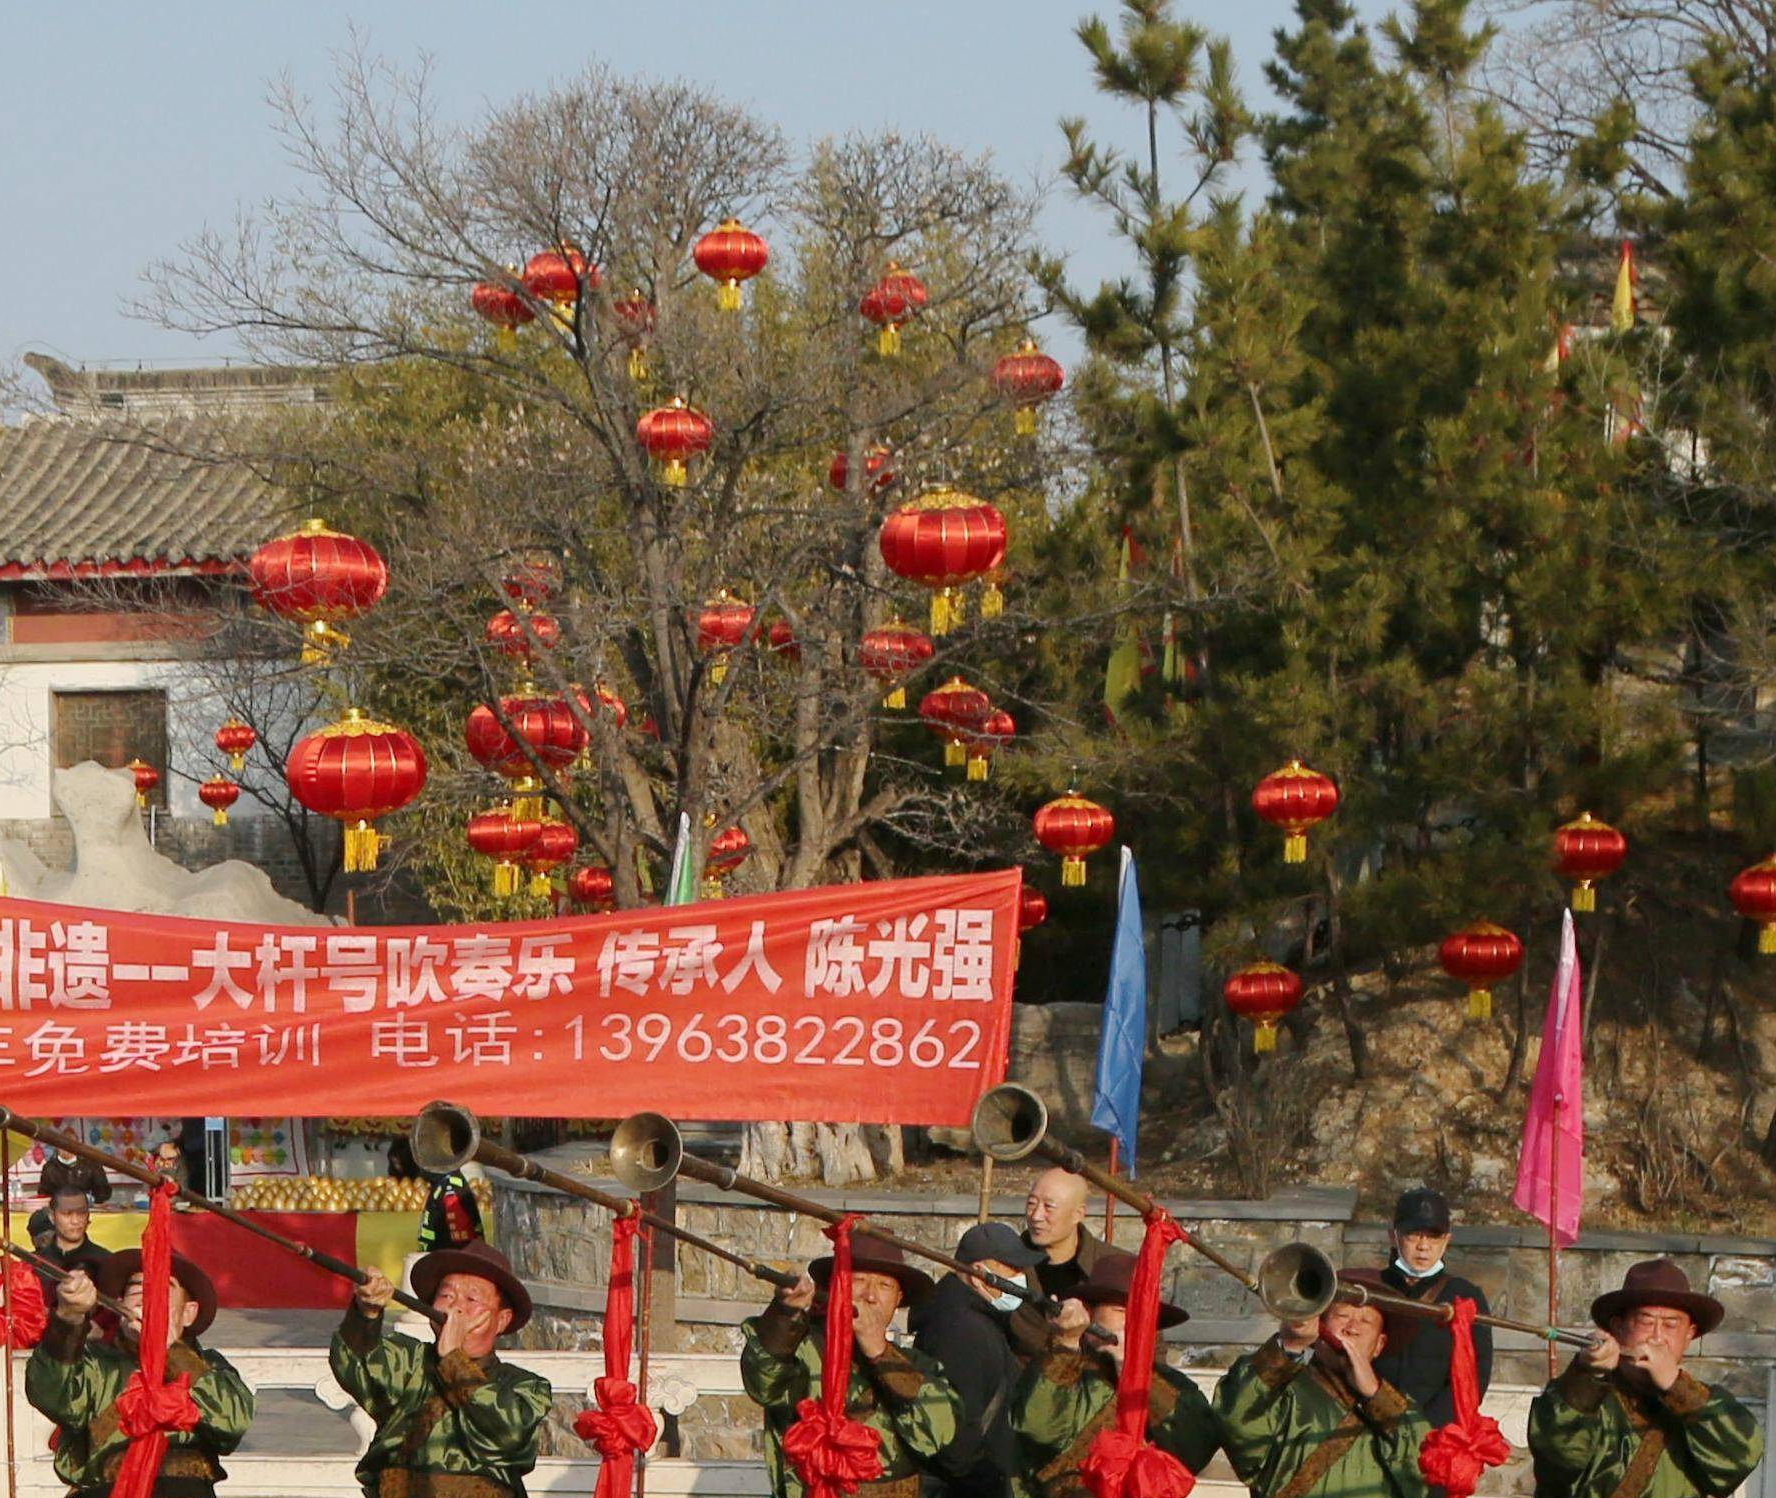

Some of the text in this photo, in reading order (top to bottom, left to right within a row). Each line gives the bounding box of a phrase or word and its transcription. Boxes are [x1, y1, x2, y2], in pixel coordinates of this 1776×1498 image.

[597, 919, 783, 998] 传承人
[804, 909, 993, 1002] 陈光强
